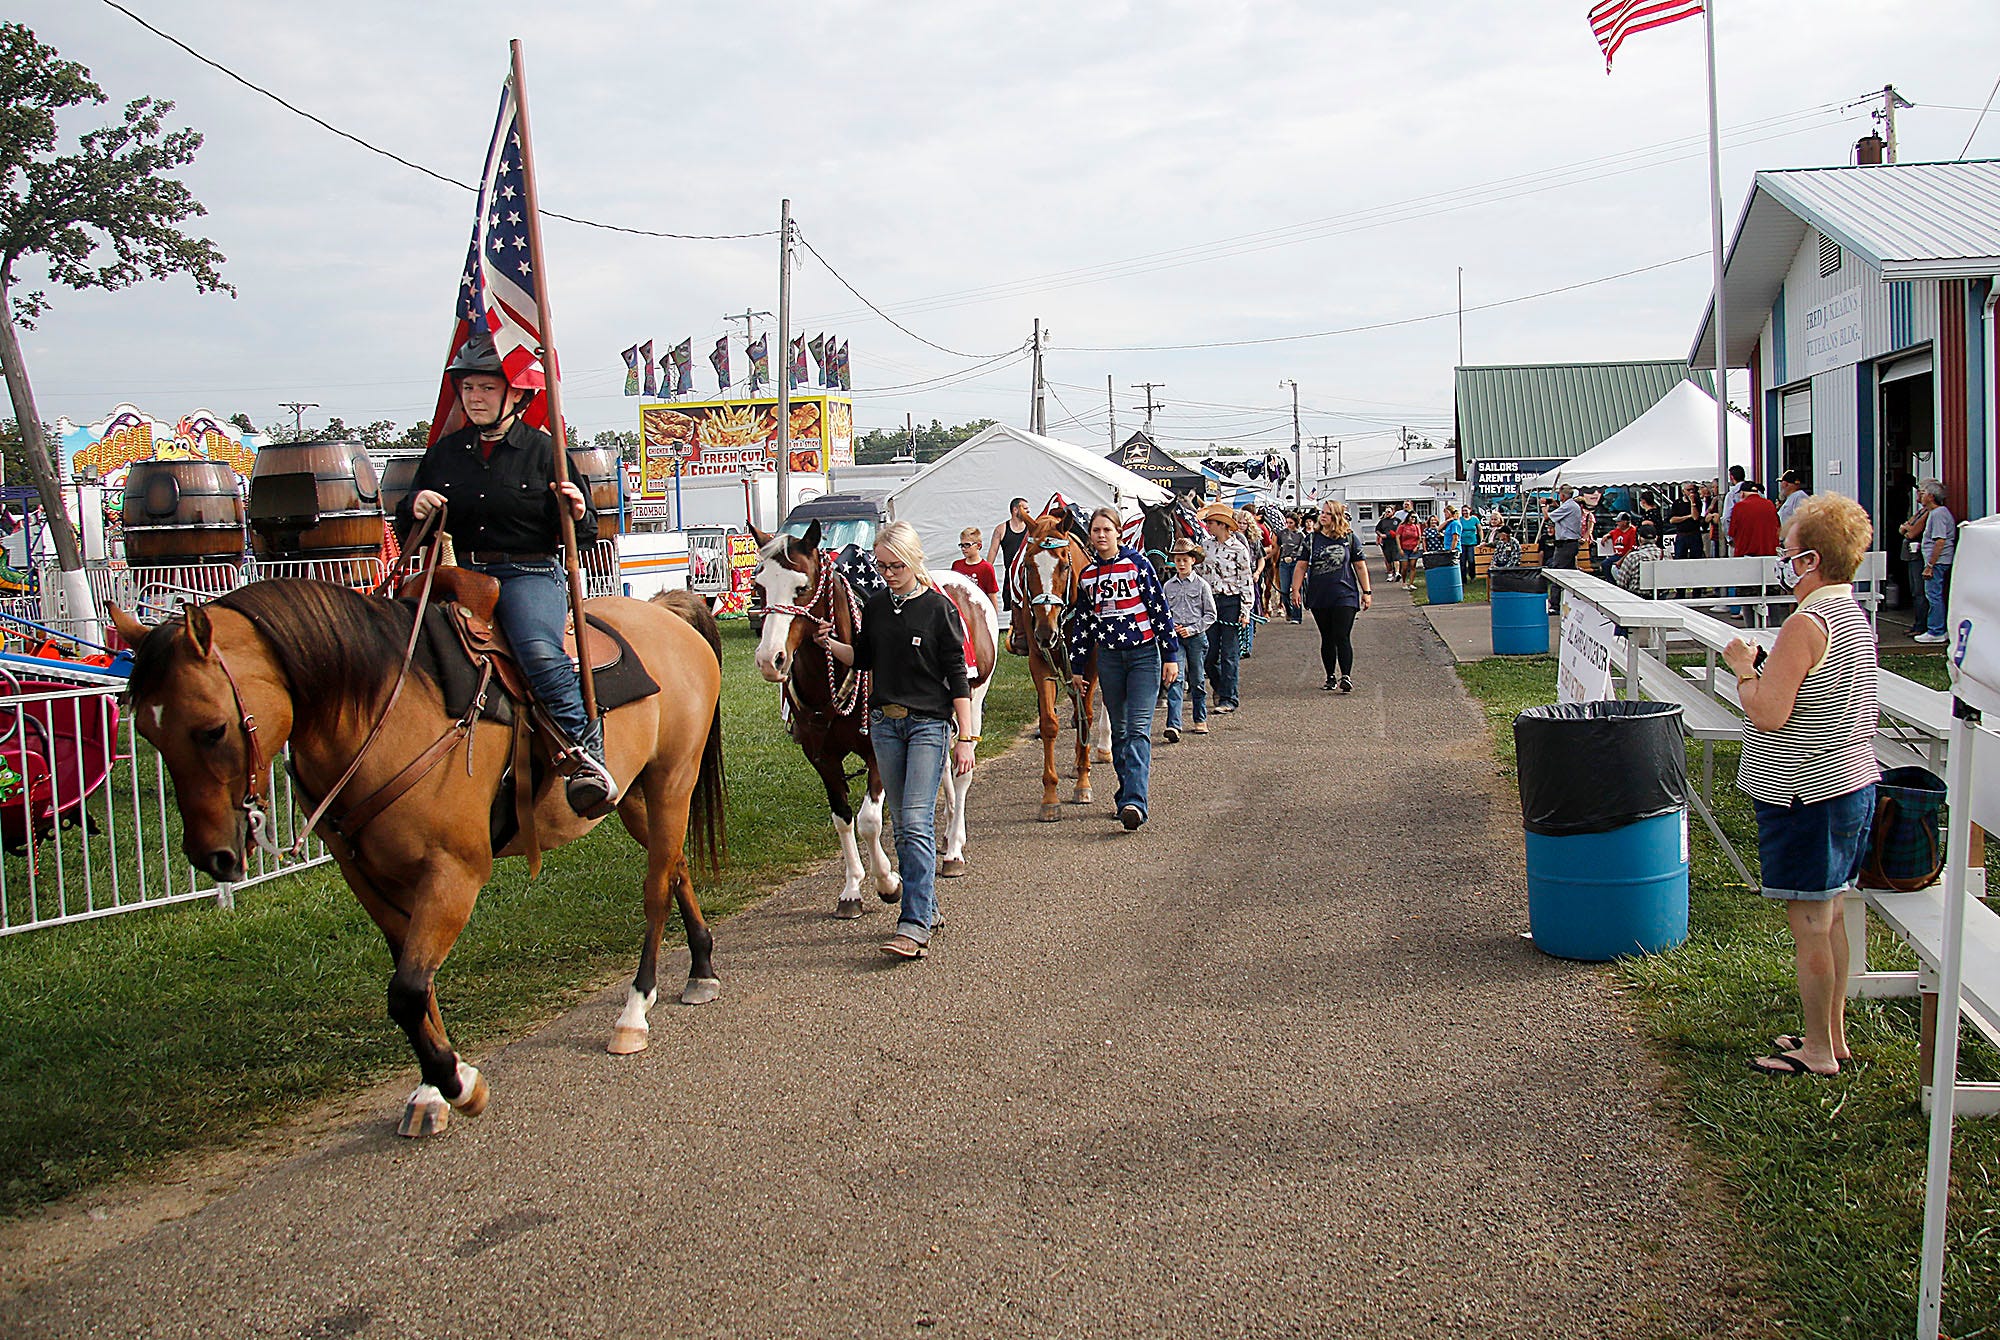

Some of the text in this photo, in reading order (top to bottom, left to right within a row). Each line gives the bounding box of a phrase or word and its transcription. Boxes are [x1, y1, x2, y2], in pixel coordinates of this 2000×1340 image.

[1806, 308, 1823, 331] FRED
[1829, 293, 1858, 321] KEARNS
[1806, 322, 1861, 357] VETERANS BLDG.
[804, 440, 819, 448] STICK
[703, 451, 761, 464] FRESH CUT
[1478, 462, 1519, 472] SAILORS
[1478, 473, 1512, 483] AREN'T
[1478, 484, 1517, 494] THEY'RE
[1086, 578, 1132, 604] USA
